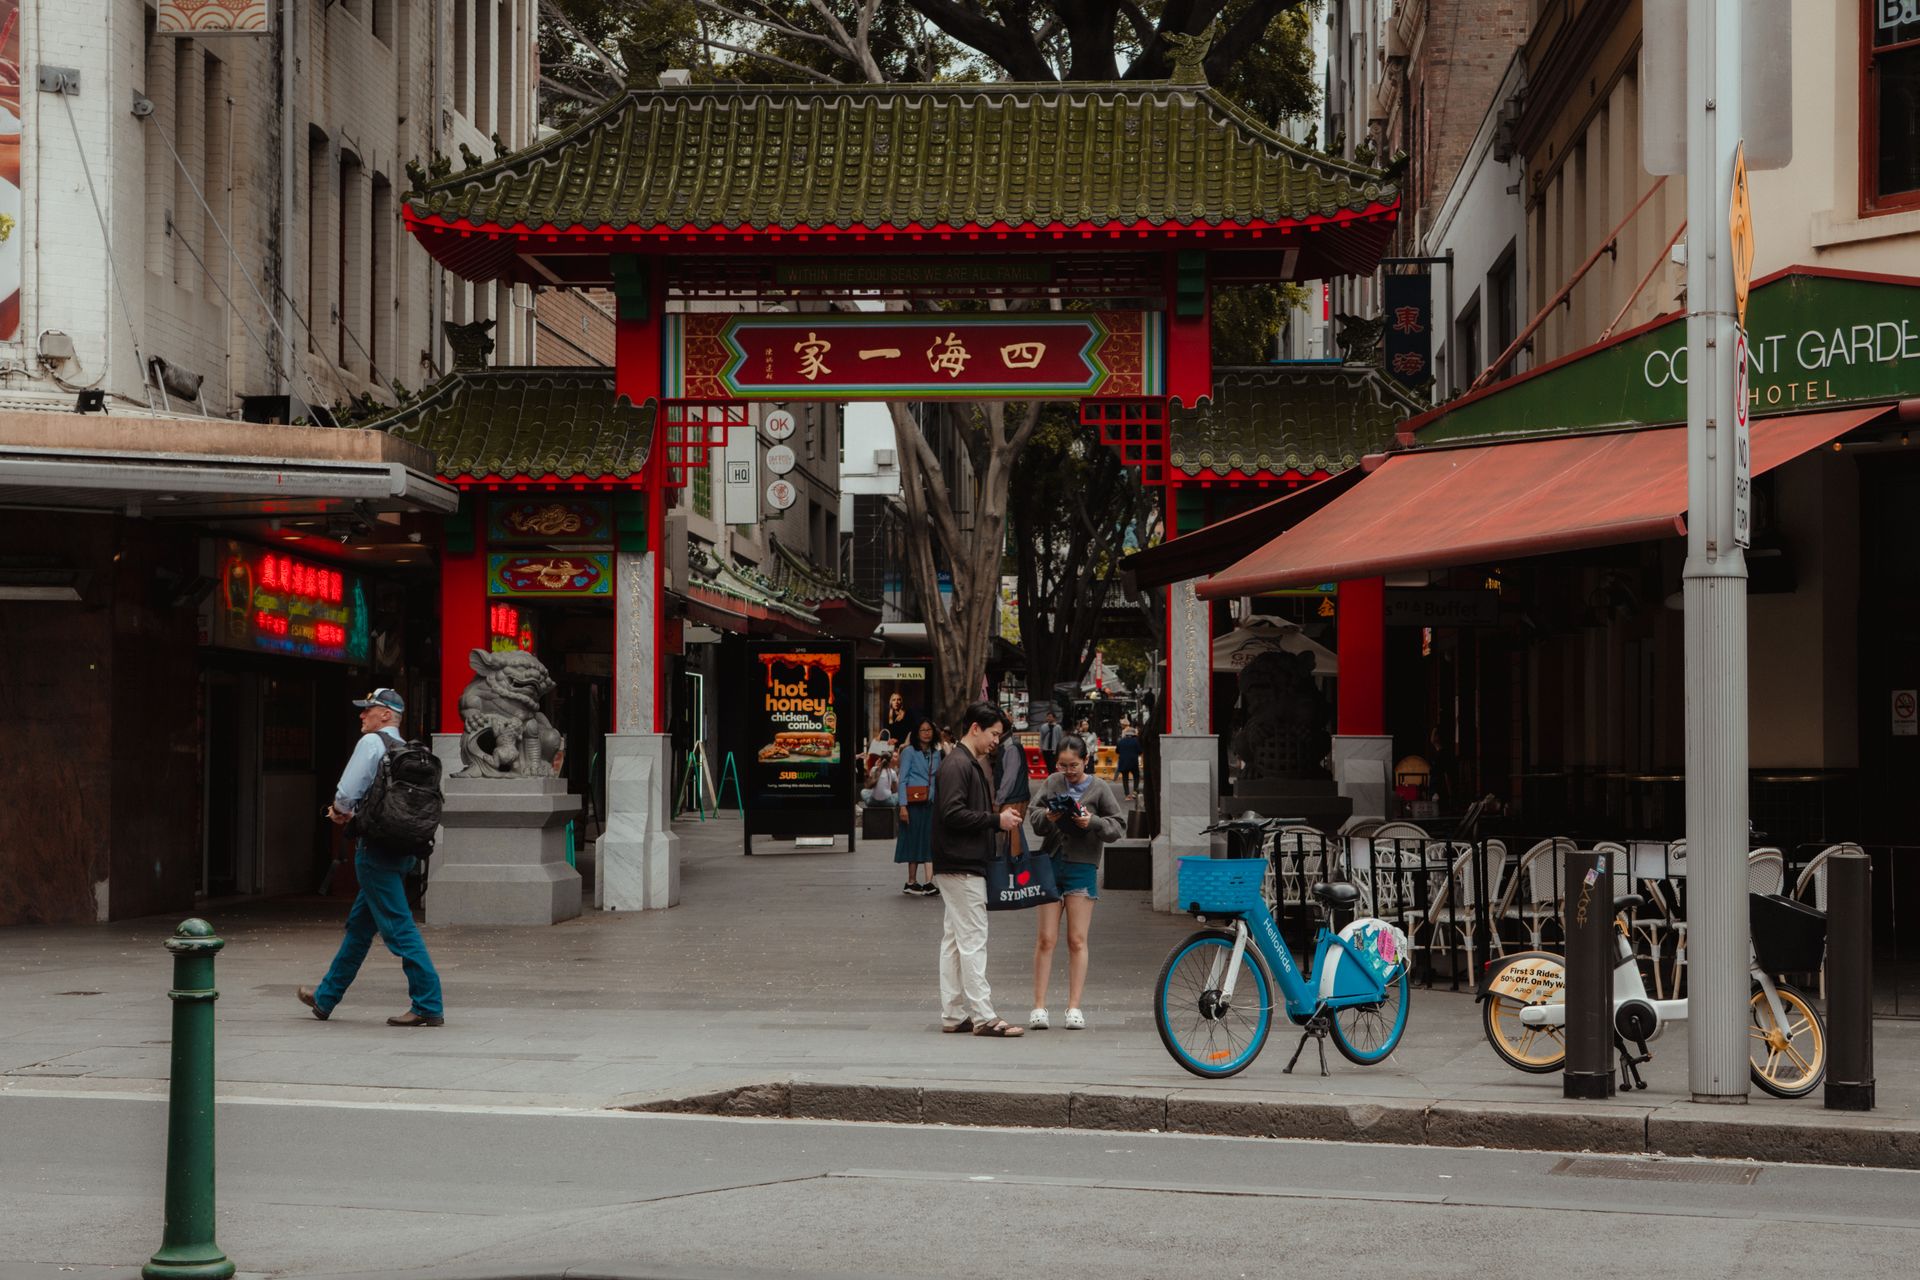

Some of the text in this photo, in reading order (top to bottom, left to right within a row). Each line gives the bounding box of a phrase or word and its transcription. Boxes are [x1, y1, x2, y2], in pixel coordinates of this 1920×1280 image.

[787, 268, 1040, 281] WITHIN THE FOUR SEAS WE ARE ALL FAMILY
[1644, 335, 1787, 388] CONT
[1748, 380, 1837, 406] HOTEL
[769, 418, 790, 431] OK
[1738, 436, 1748, 468] NO
[734, 469, 747, 480] HQ
[773, 679, 808, 697] hot
[765, 694, 826, 717] honey
[771, 712, 809, 722] chicken
[788, 720, 823, 730] combo
[779, 771, 817, 780] SUBWAY
[1008, 873, 1015, 889] I
[1263, 917, 1292, 973] HelloRide
[1510, 967, 1529, 975] First
[1536, 969, 1562, 979] Rides.
[1500, 975, 1515, 983] 50%
[1516, 976, 1530, 984] Off.
[1531, 978, 1542, 986] On
[1542, 979, 1555, 988] My
